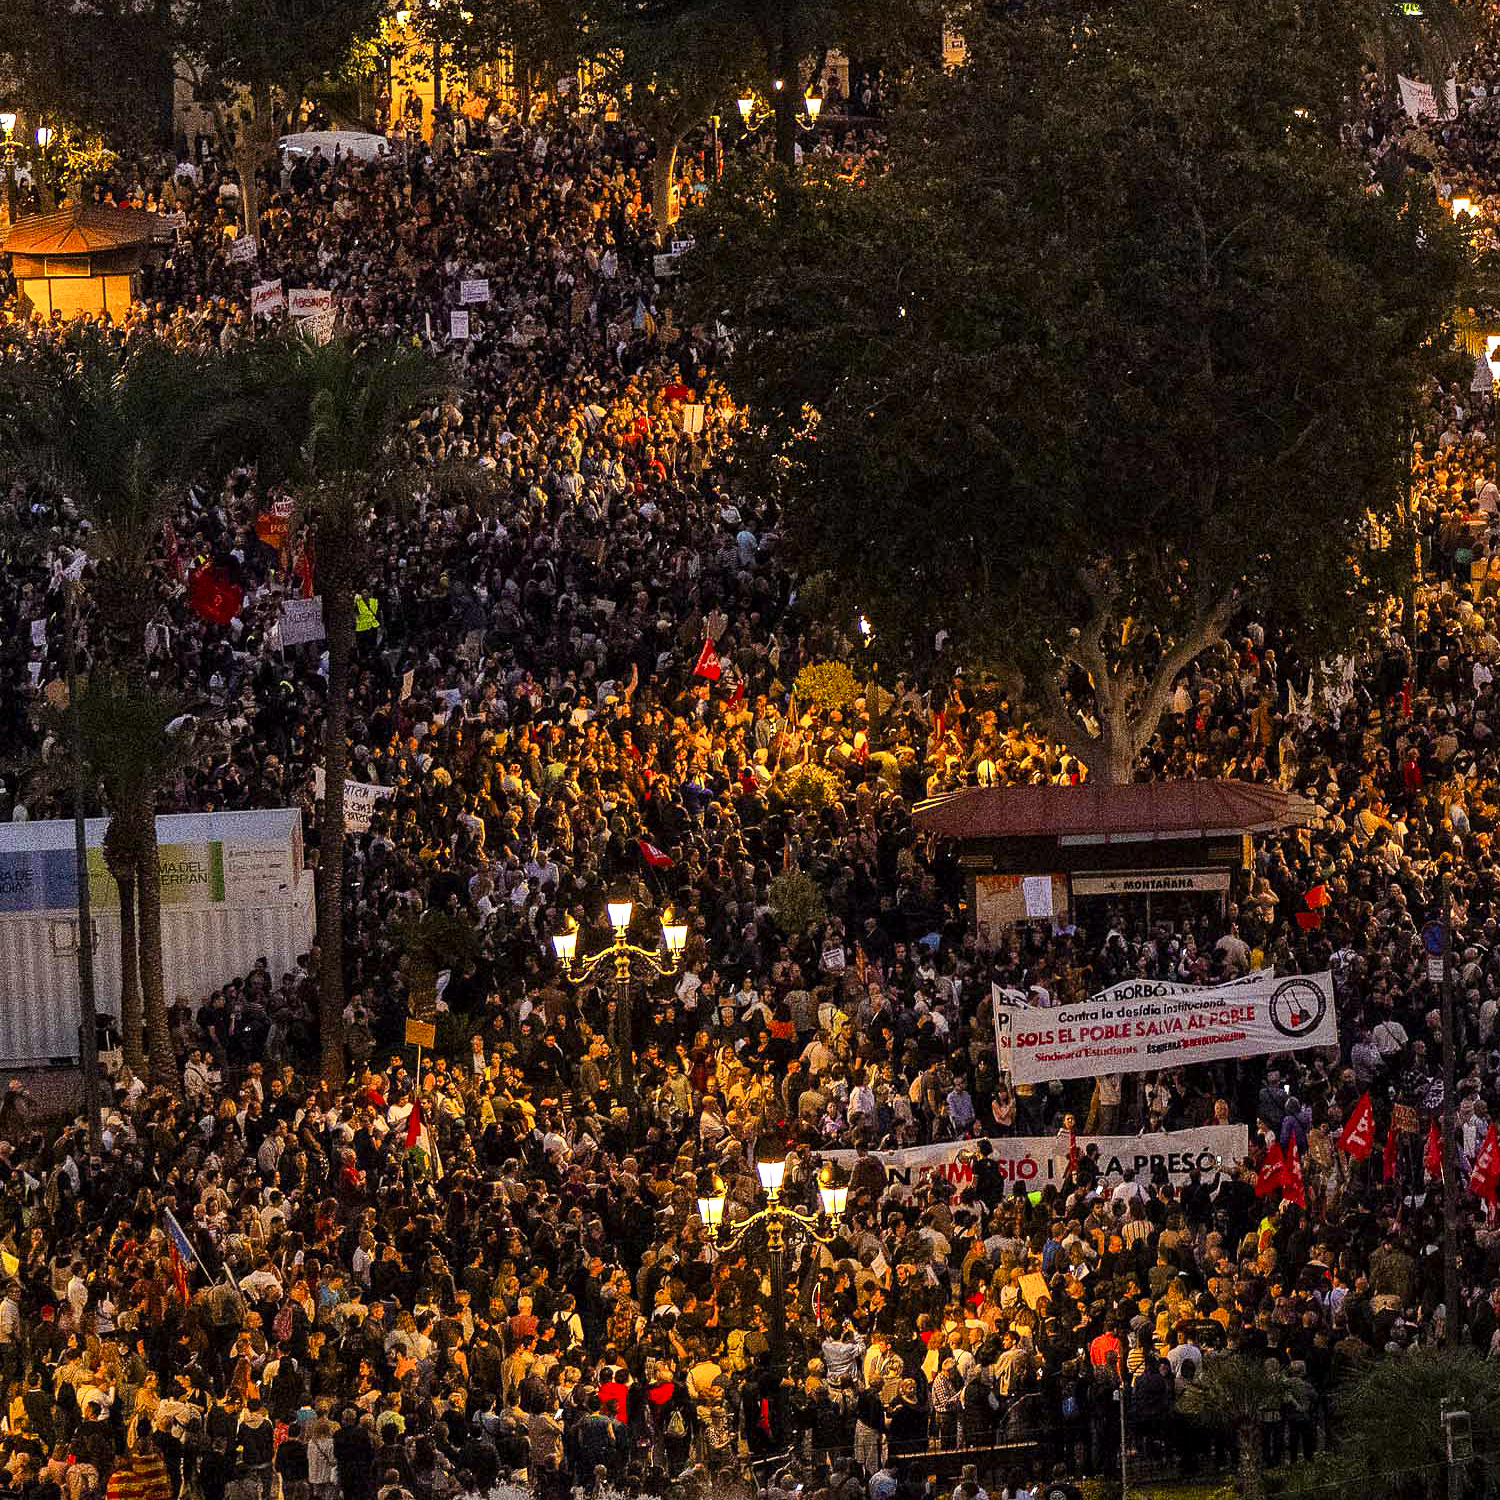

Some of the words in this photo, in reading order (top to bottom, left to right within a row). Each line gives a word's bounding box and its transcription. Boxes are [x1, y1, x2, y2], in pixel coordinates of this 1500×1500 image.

[1114, 982, 1168, 1001] BORBÓ
[1058, 1010, 1099, 1023] Contra
[1101, 1007, 1114, 1020] la
[1116, 1001, 1162, 1019] desídia
[1016, 1030, 1054, 1048] SOLS
[1058, 1028, 1076, 1044] EL
[1079, 1021, 1132, 1043] POBLE
[1135, 1016, 1183, 1037] SALVA
[1187, 1014, 1206, 1030] AL
[1209, 1004, 1256, 1027] POBLE
[1133, 1147, 1215, 1177] PRESÓ
